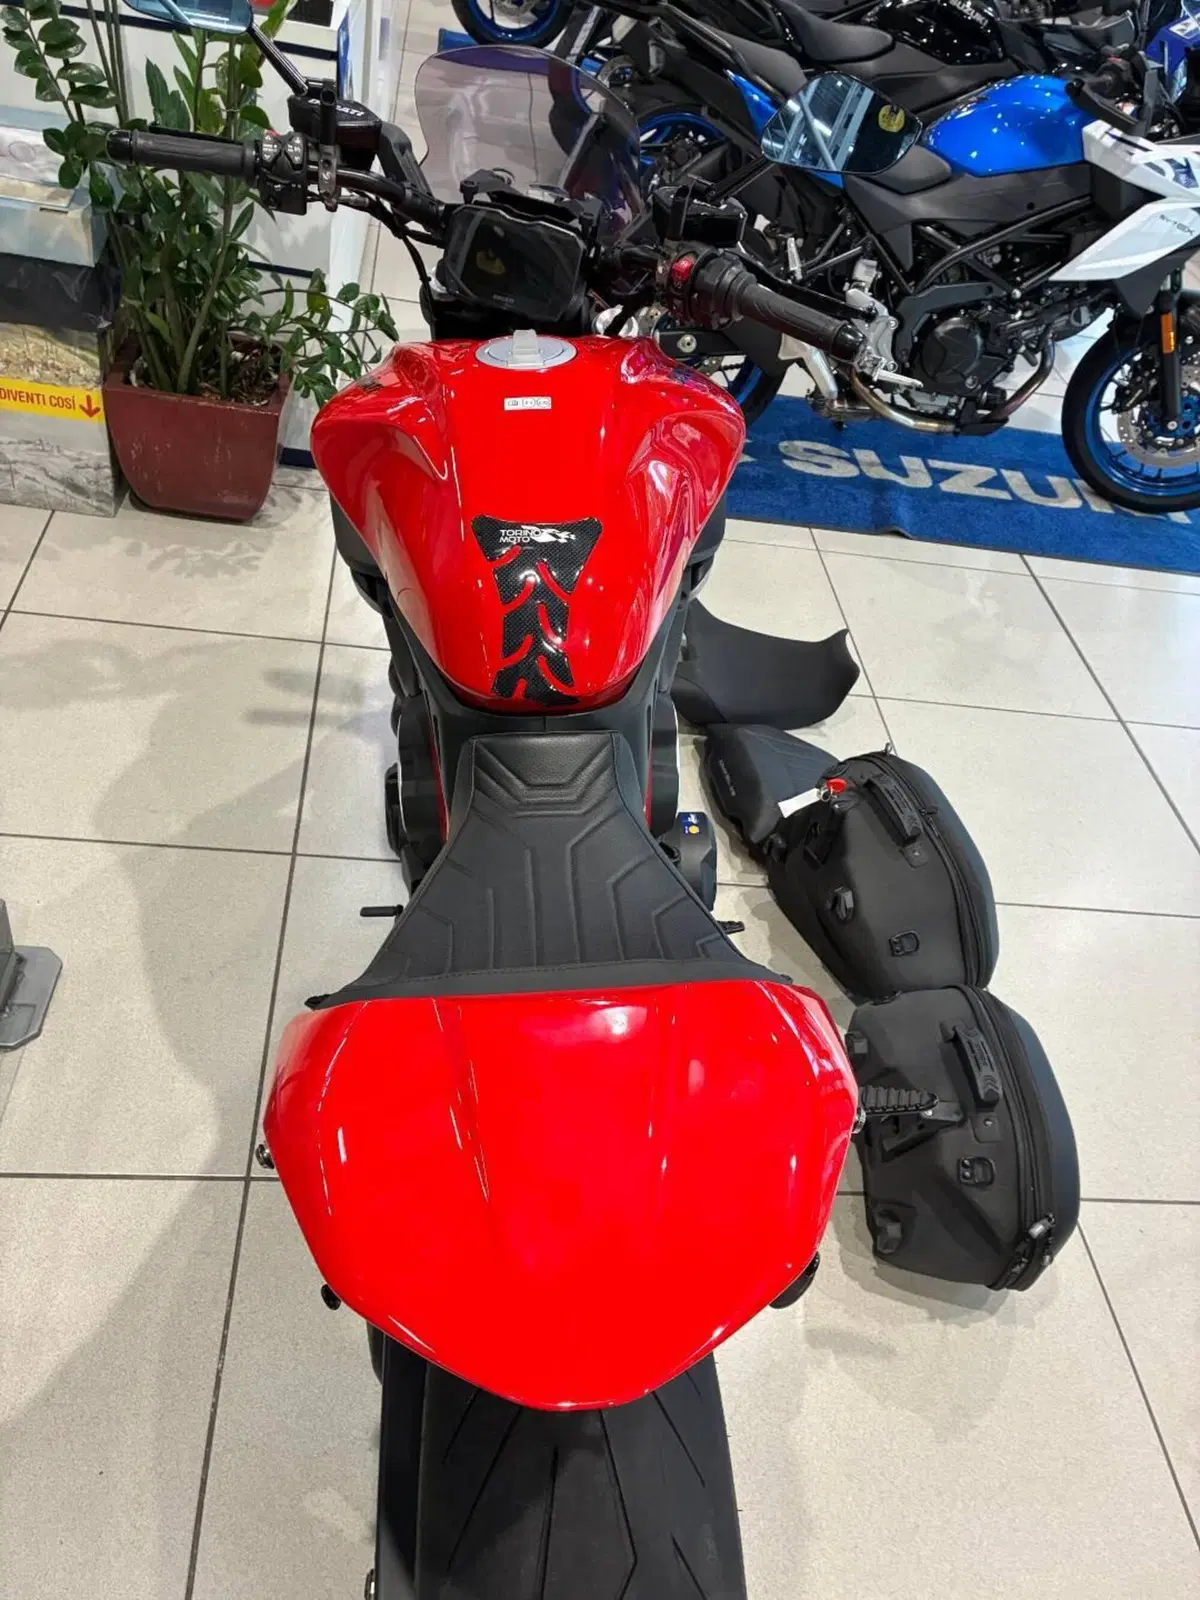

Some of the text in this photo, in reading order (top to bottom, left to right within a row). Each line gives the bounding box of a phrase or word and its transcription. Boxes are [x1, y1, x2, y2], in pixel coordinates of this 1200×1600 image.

[308, 98, 365, 117] DCATI
[0, 387, 46, 406] DIVENTI
[778, 440, 1192, 524] SUZU
[500, 529, 541, 537] TORINO
